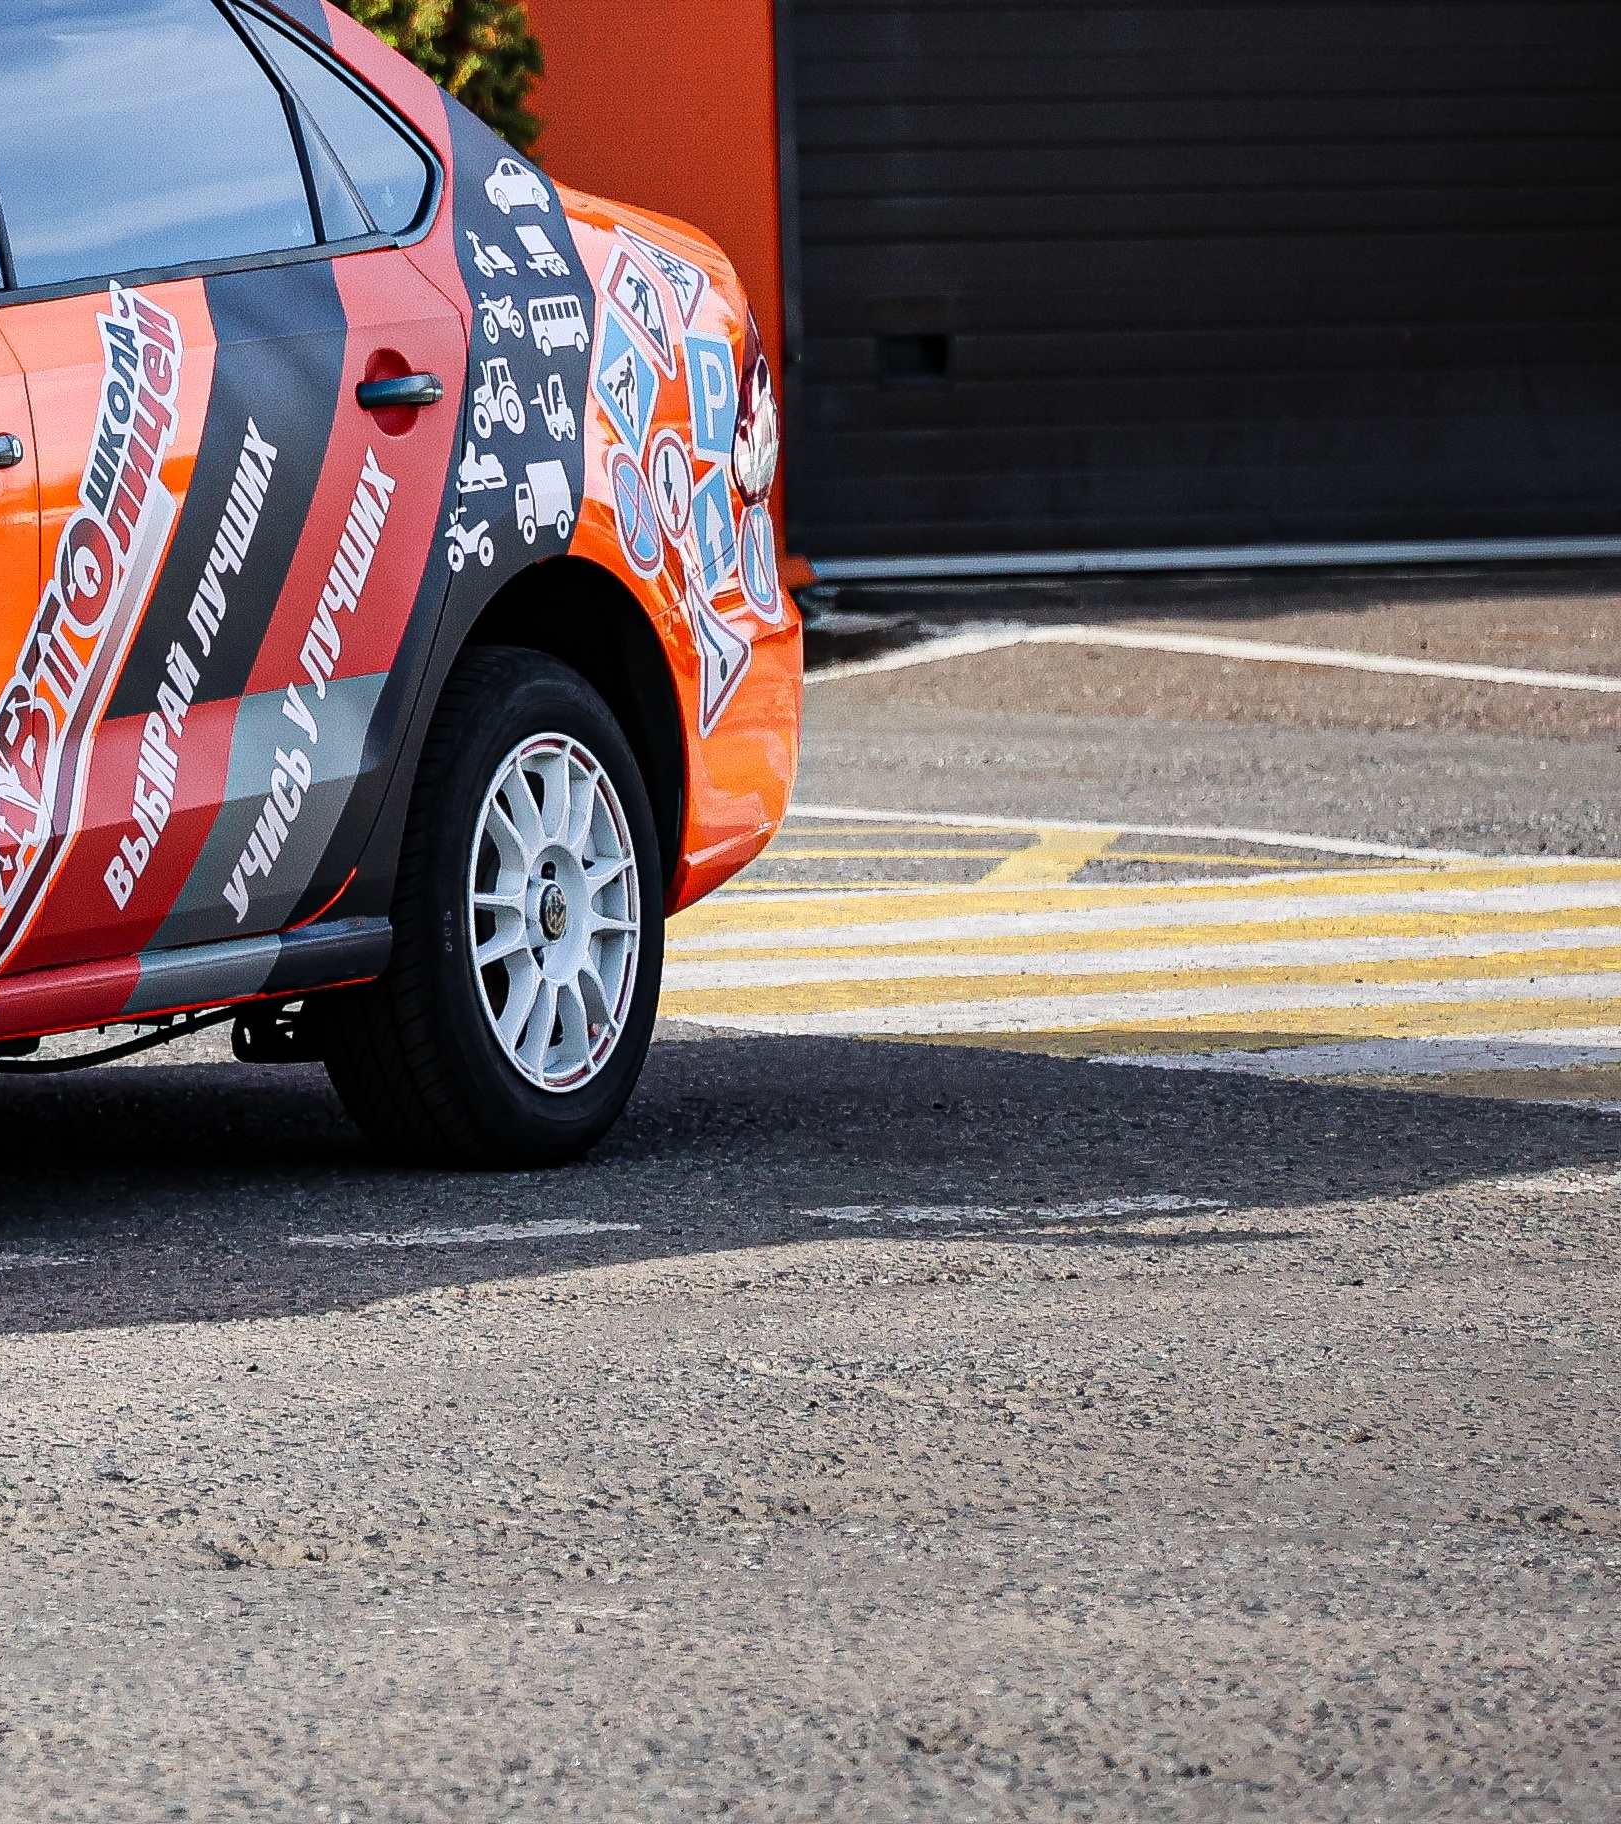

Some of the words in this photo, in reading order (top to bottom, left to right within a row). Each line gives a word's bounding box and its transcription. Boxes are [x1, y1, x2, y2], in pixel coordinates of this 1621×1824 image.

[85, 320, 139, 517] ШКОЛА
[107, 290, 176, 557] лицей
[103, 640, 201, 911] ВЫБИРАЙ
[187, 416, 279, 657] ЛУЧШИХ
[299, 444, 397, 700] ЛУЧШИХ
[281, 681, 320, 745] У
[222, 745, 313, 925] УЧИСЬ
